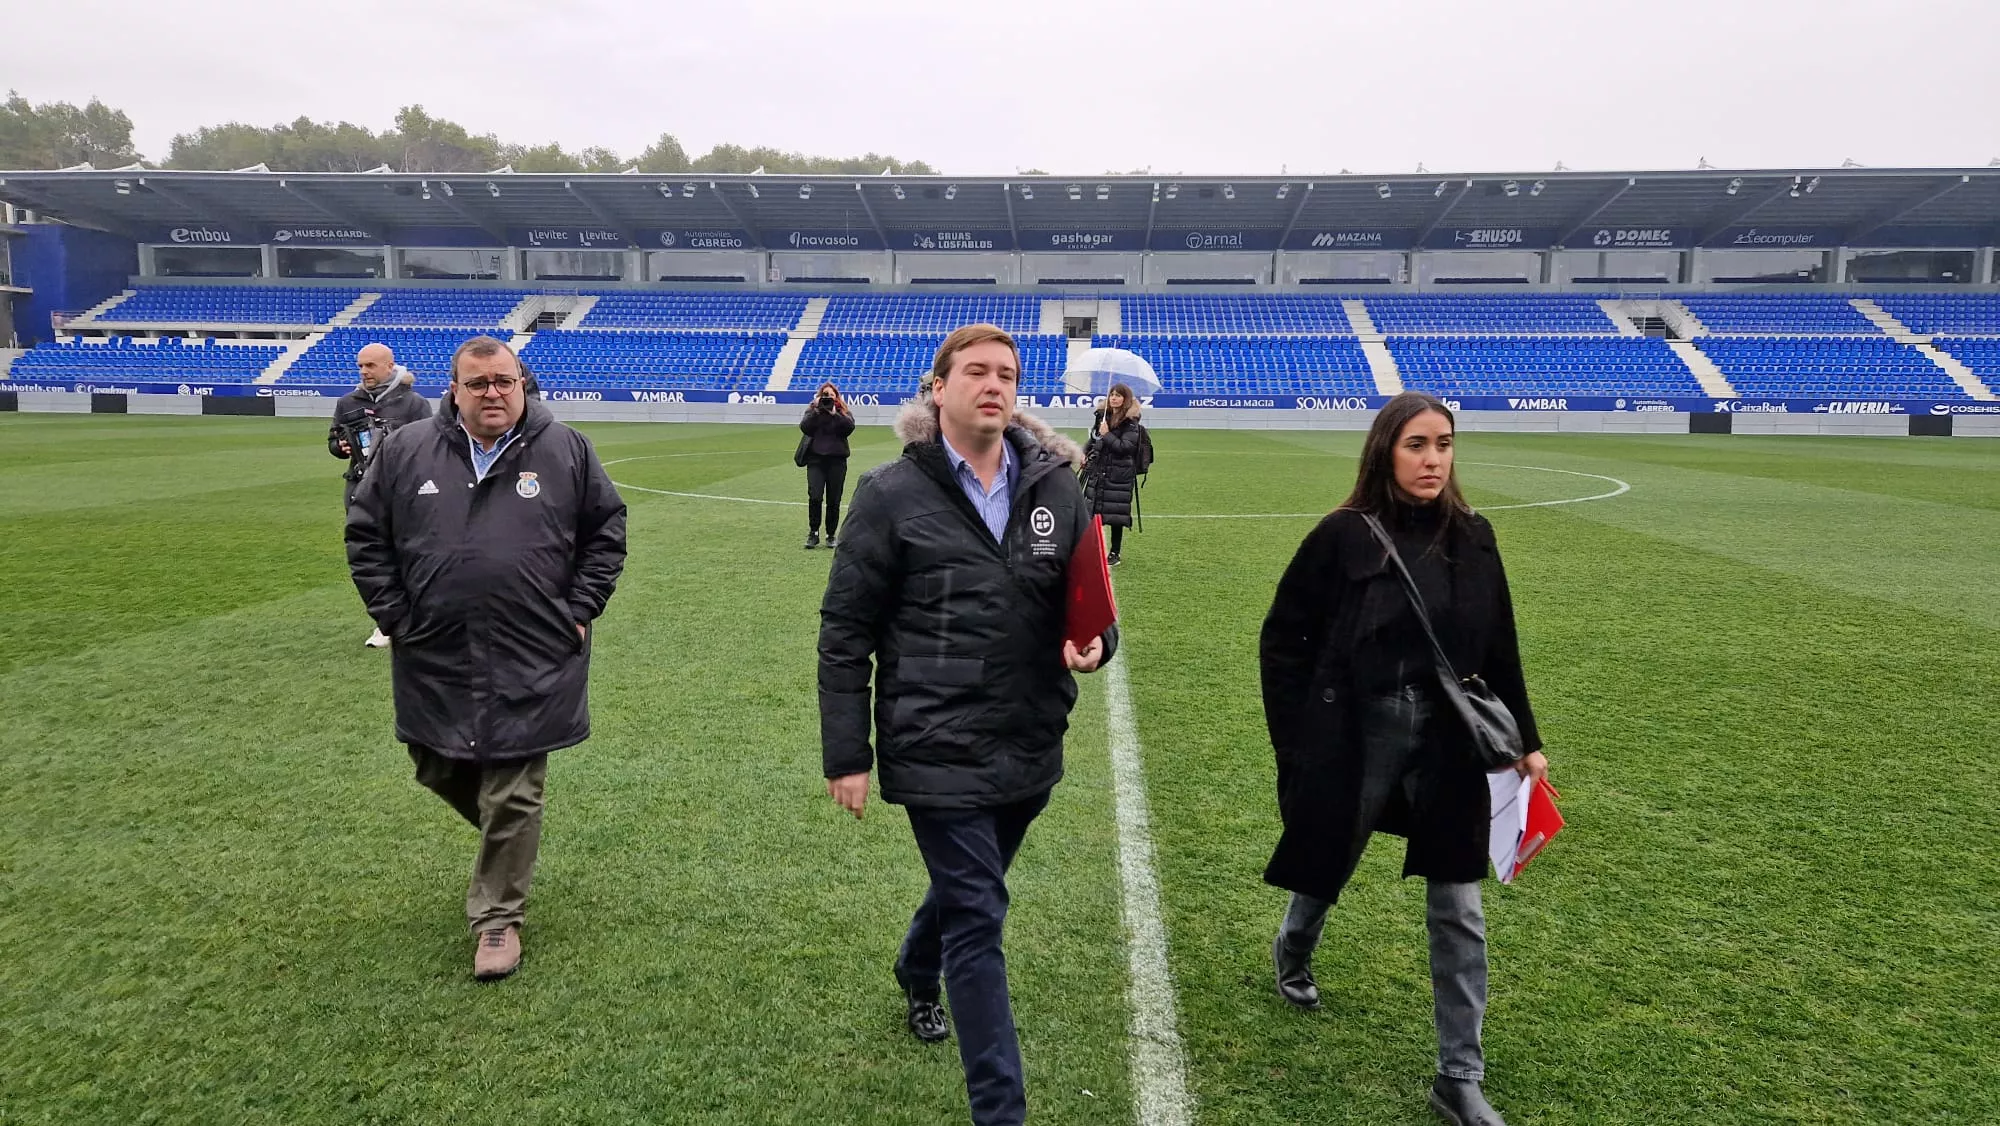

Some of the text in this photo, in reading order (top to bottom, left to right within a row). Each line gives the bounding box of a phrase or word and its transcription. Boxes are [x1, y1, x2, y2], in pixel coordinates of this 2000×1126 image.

[170, 227, 231, 242] embou
[295, 229, 372, 239] HUESCA GARDE
[1051, 232, 1114, 246] gashogar
[1204, 232, 1243, 246] arnal
[1336, 232, 1382, 242] MAZANA
[1615, 230, 1671, 241] DOMEC
[1753, 233, 1814, 245] ecomputer
[691, 238, 742, 248] CABRERO
[802, 235, 858, 246] navasola
[938, 240, 993, 249] LOSFABLOS
[193, 387, 214, 396] MST
[273, 389, 321, 397] COSEHISA
[553, 391, 602, 401] CALLIZO
[641, 391, 685, 403] AMBAR
[743, 392, 776, 405] soka
[1016, 396, 1042, 408] EL
[1296, 397, 1367, 410] SOMMOS
[1519, 399, 1568, 410] AMBAR
[1731, 402, 1788, 413] CaixaBank
[1828, 402, 1890, 414] CLAVERIA
